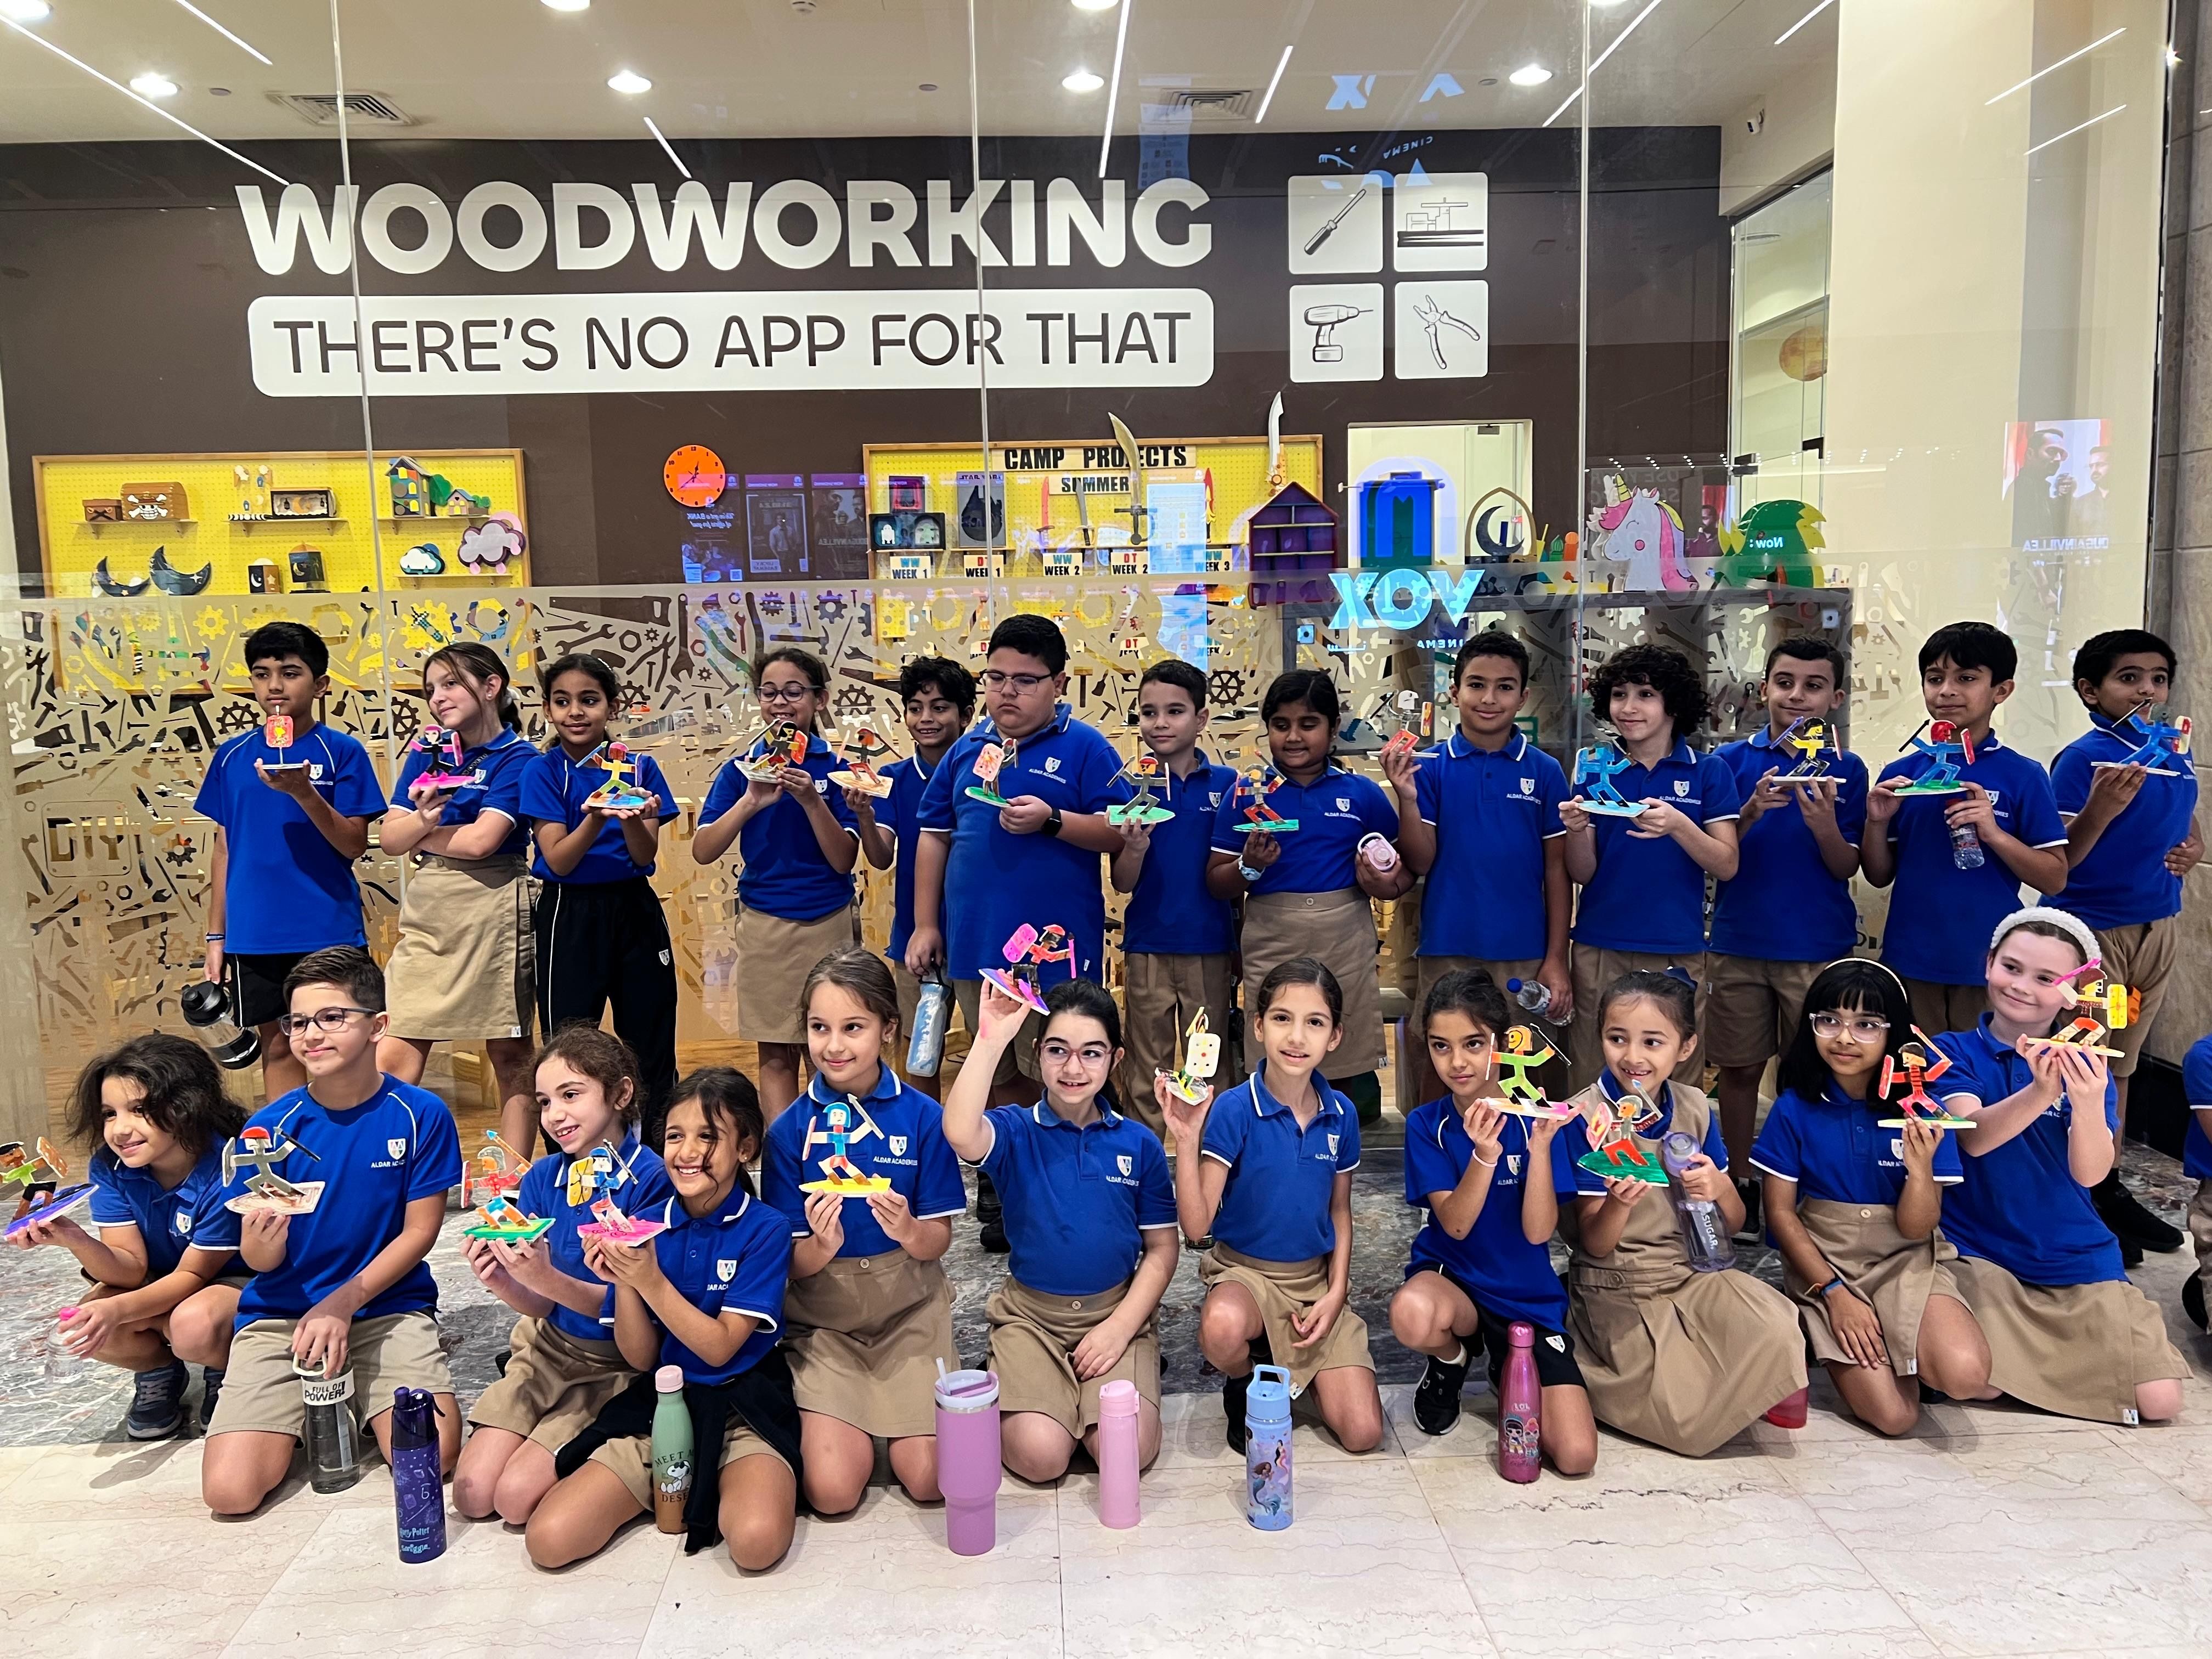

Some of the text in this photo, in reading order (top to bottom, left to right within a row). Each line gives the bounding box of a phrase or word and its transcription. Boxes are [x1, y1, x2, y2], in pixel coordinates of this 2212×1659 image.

[235, 177, 1212, 275] WOODWORKING
[273, 312, 1191, 373] THERE'S NO APP FOR THAT
[1005, 446, 1187, 469] CAMP PROECTS
[1062, 476, 1129, 493] SUMMER
[900, 557, 920, 568] WW
[1053, 554, 1072, 564] WW
[1045, 565, 1080, 575] WEEK 2
[1112, 564, 1148, 574] WEEK 2
[1224, 561, 1230, 571] 3
[892, 568, 928, 579] WEEK 1
[995, 567, 1000, 577] 1
[47, 815, 124, 862] DIY
[873, 1155, 891, 1164] ALDAR
[312, 1382, 342, 1394] FULL OF
[654, 1451, 684, 1468] MEET
[412, 1527, 430, 1539] Potter
